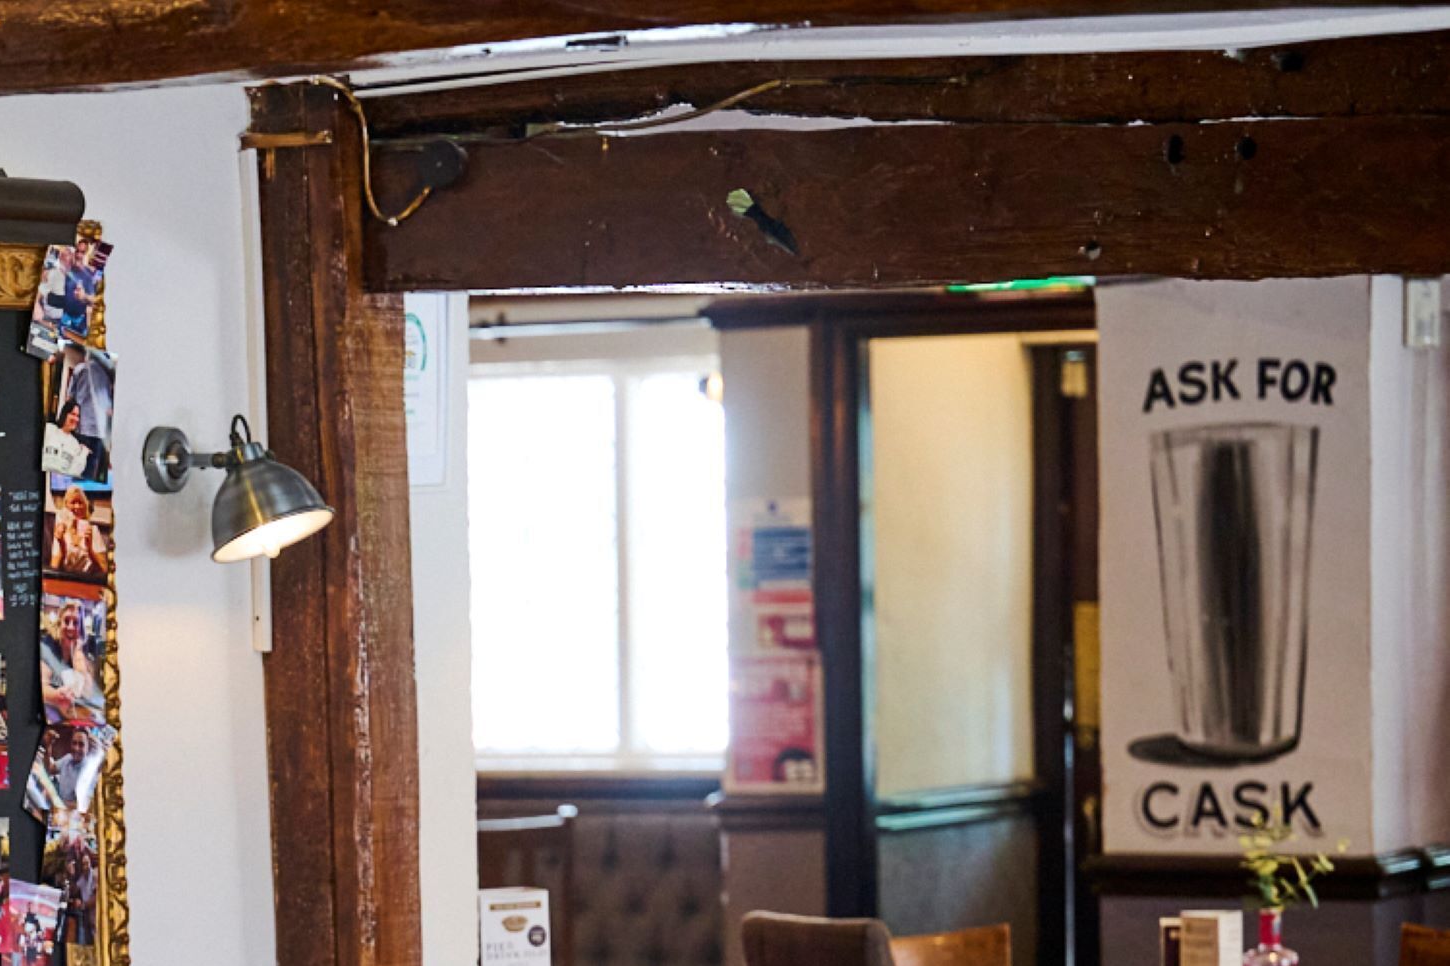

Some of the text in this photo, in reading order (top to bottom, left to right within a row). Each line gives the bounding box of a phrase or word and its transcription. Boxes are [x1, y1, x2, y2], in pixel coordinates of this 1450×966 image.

[1143, 357, 1336, 414] ASK FOR
[1140, 779, 1322, 833] CASK
